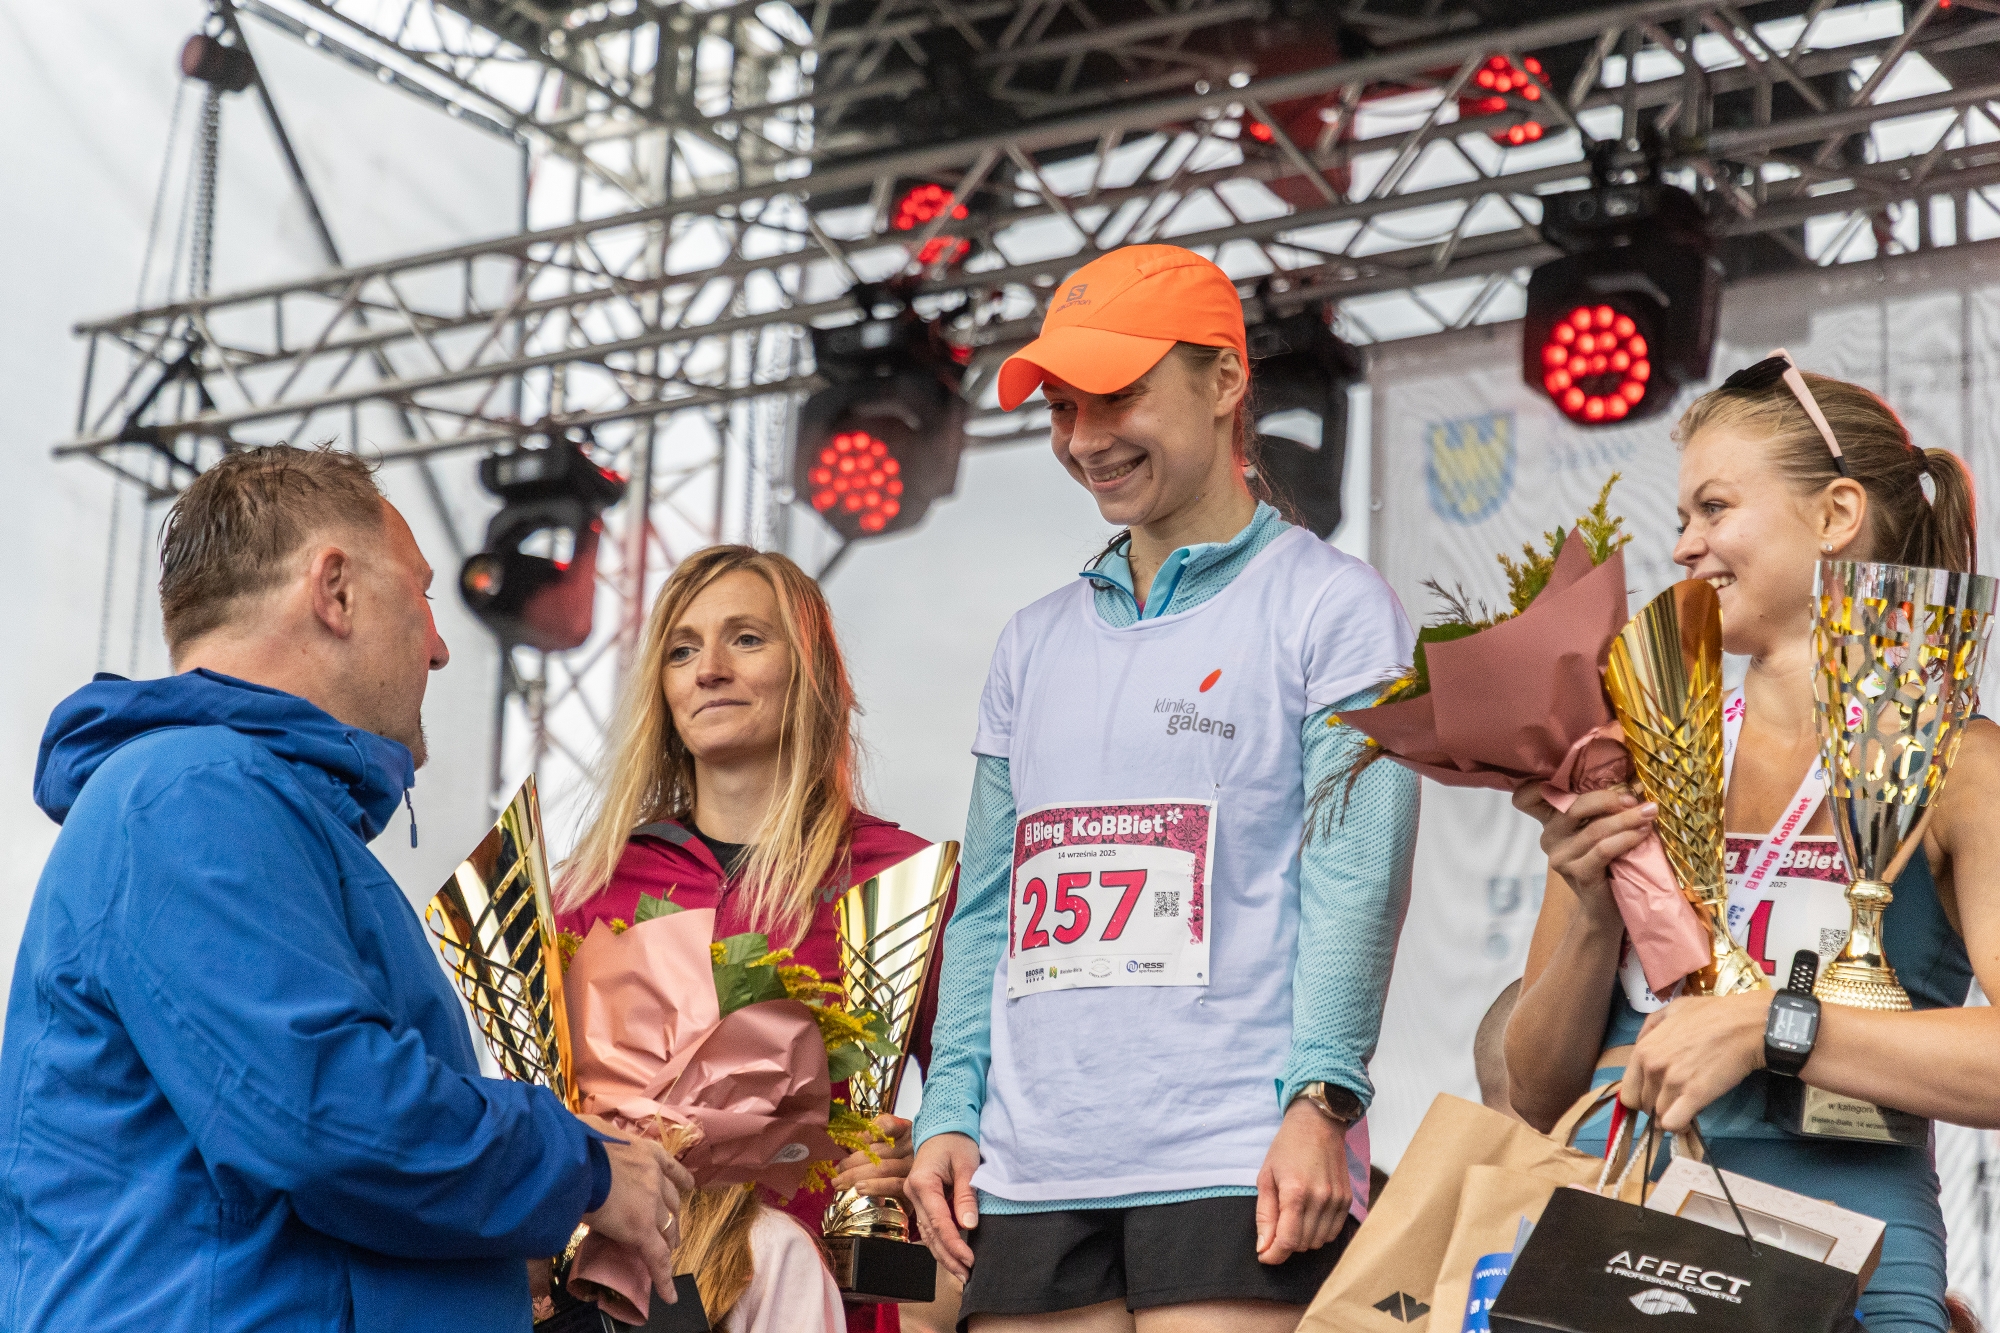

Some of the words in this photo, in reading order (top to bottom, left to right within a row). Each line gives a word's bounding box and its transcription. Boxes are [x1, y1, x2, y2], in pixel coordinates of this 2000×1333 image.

[1154, 698, 1196, 714] klinika
[1166, 711, 1236, 740] galena
[1033, 821, 1064, 844] Bieg
[1072, 813, 1164, 837] KoBBiet
[1750, 850, 1780, 880] Bieg
[1770, 797, 1812, 846] KoBBiet
[1058, 851, 1066, 859] 14
[1067, 850, 1098, 859] września
[1099, 849, 1117, 857] 2025
[1022, 869, 1148, 951] 257
[1608, 1251, 1751, 1295] AFFECT
[1613, 1267, 1685, 1290] PROFESSIONAL
[1685, 1284, 1743, 1304] COSMETICS
